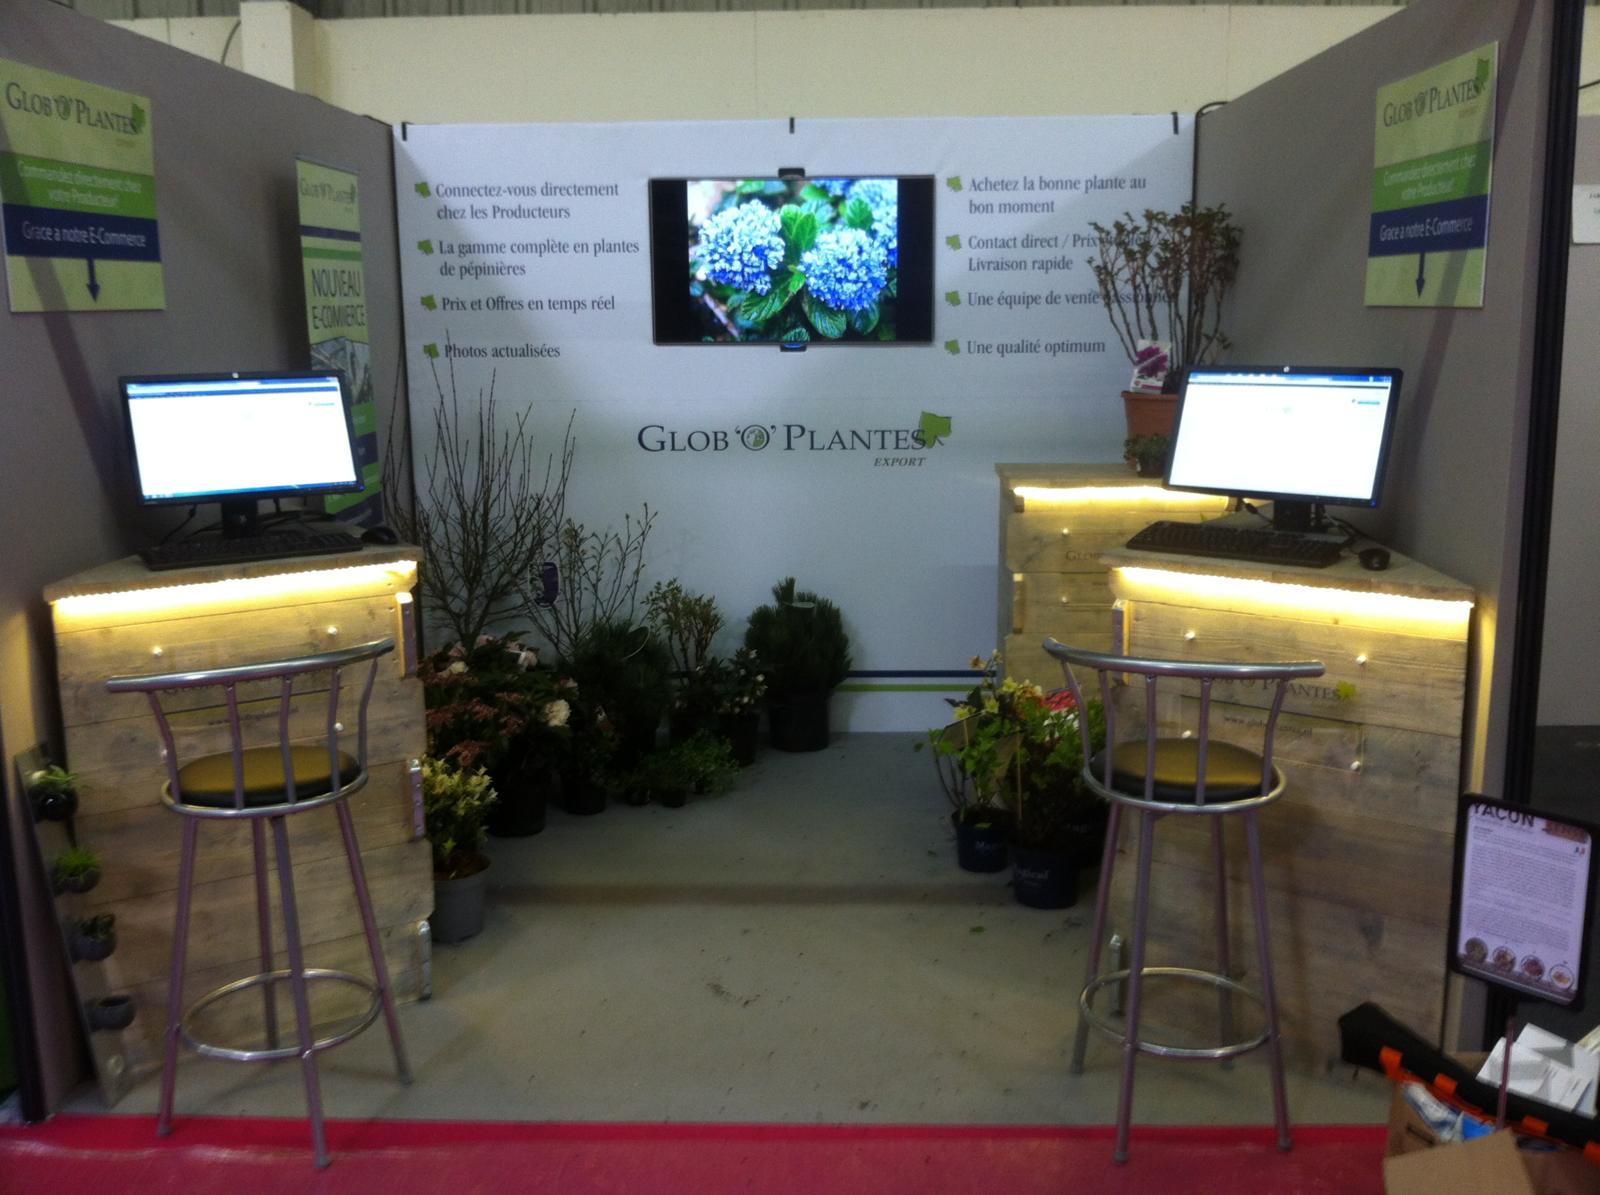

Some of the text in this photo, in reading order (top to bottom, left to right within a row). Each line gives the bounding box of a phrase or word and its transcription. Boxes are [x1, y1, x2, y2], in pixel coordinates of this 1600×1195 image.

[6, 82, 52, 117] GLOB
[435, 181, 619, 198] Connectez-vous directement
[968, 175, 1147, 193] Achetez la bonne plante au
[437, 204, 571, 220] chez les Producteurs
[969, 200, 1055, 214] bon moment
[439, 238, 640, 258] La gamme complète en plantes
[968, 235, 1018, 249] Contact
[1021, 234, 1058, 249] direct
[1072, 233, 1098, 248] Prix
[440, 261, 526, 280] de pépinières
[968, 256, 1074, 274] Livraison rapide
[311, 267, 361, 297] NOUVEAU
[442, 295, 616, 314] Prix et Offres en temps réel
[968, 292, 993, 306] Une
[997, 291, 1042, 310] équipe
[1045, 291, 1062, 305] de
[1065, 292, 1100, 305] vente
[444, 343, 561, 358] Photos actualisées
[967, 339, 1106, 358] Une qualité optimum
[637, 424, 729, 452] GLOB
[783, 424, 926, 451] PLANTES
[873, 456, 926, 467] EXPORT
